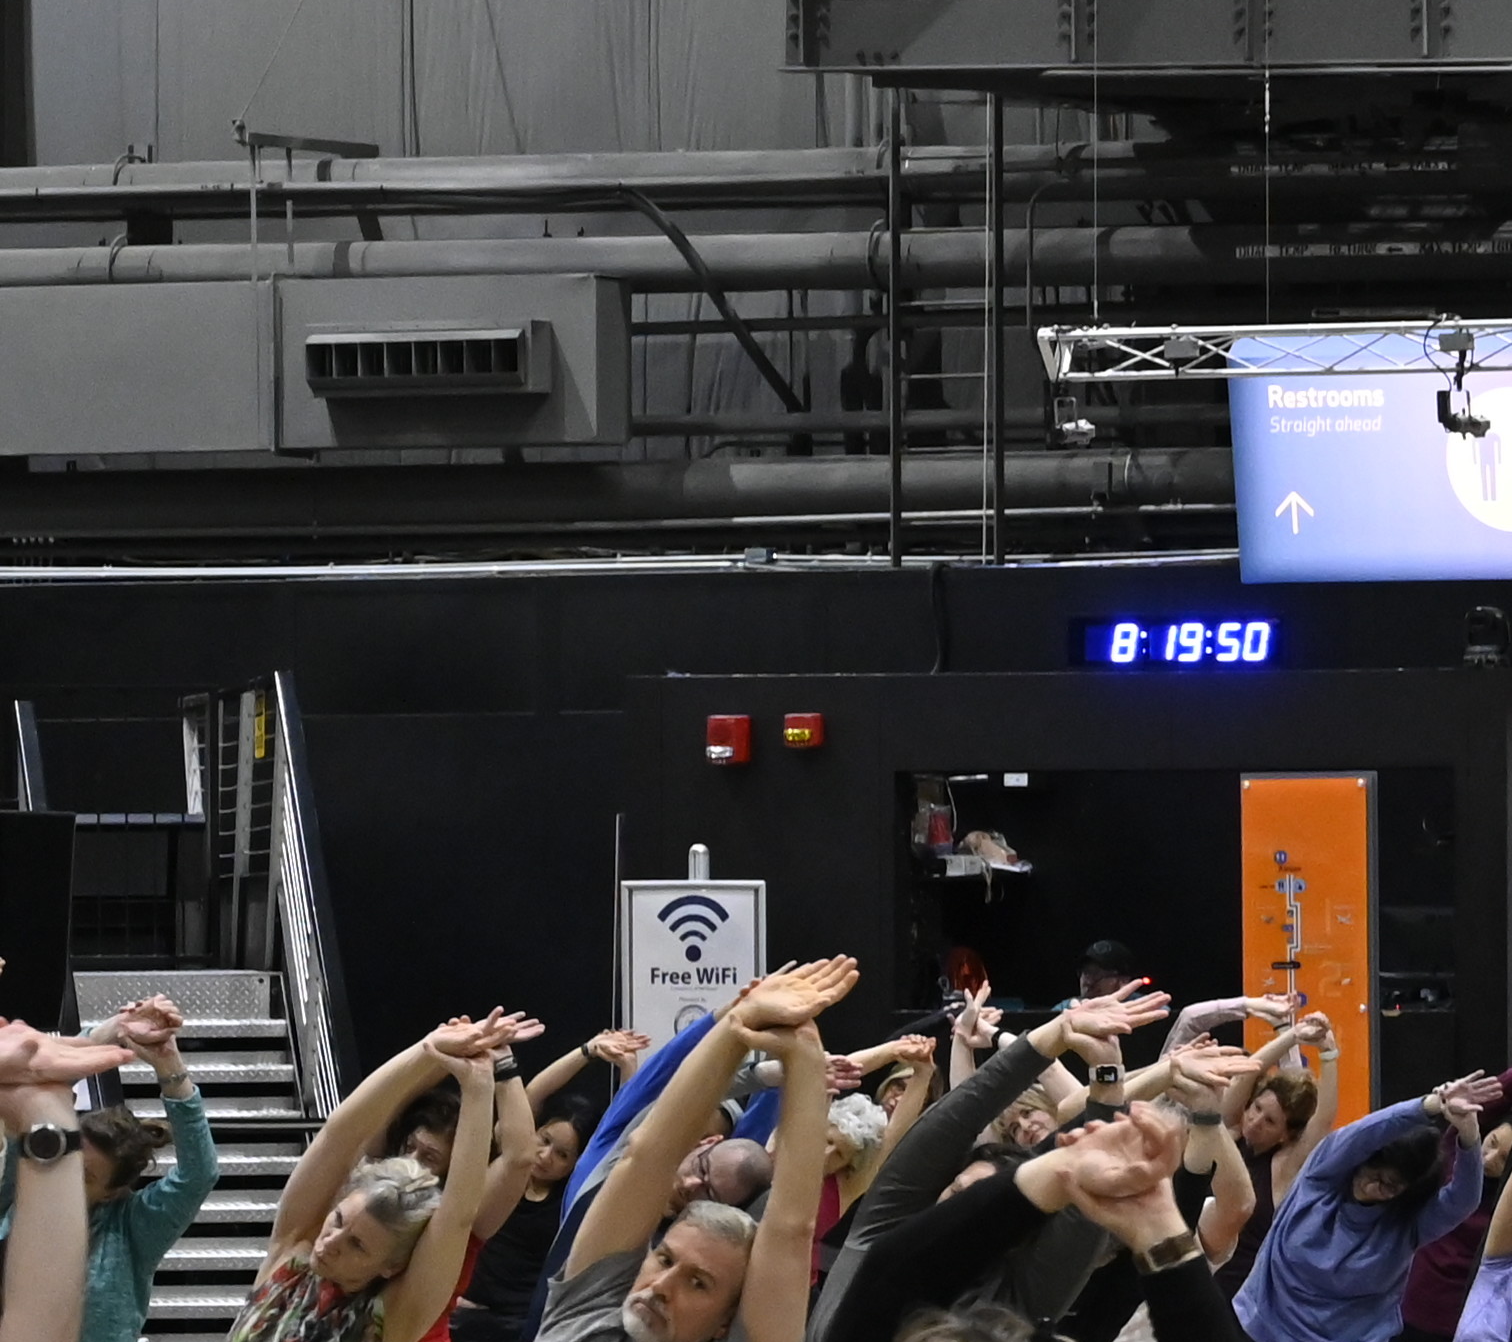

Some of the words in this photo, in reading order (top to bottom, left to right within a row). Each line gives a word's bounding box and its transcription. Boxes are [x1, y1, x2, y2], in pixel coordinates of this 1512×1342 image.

[1267, 384, 1385, 409] Restrooms
[1270, 415, 1332, 437] Straight
[1335, 414, 1382, 432] ahead
[650, 967, 692, 985] Free
[696, 966, 738, 985] WiFi
